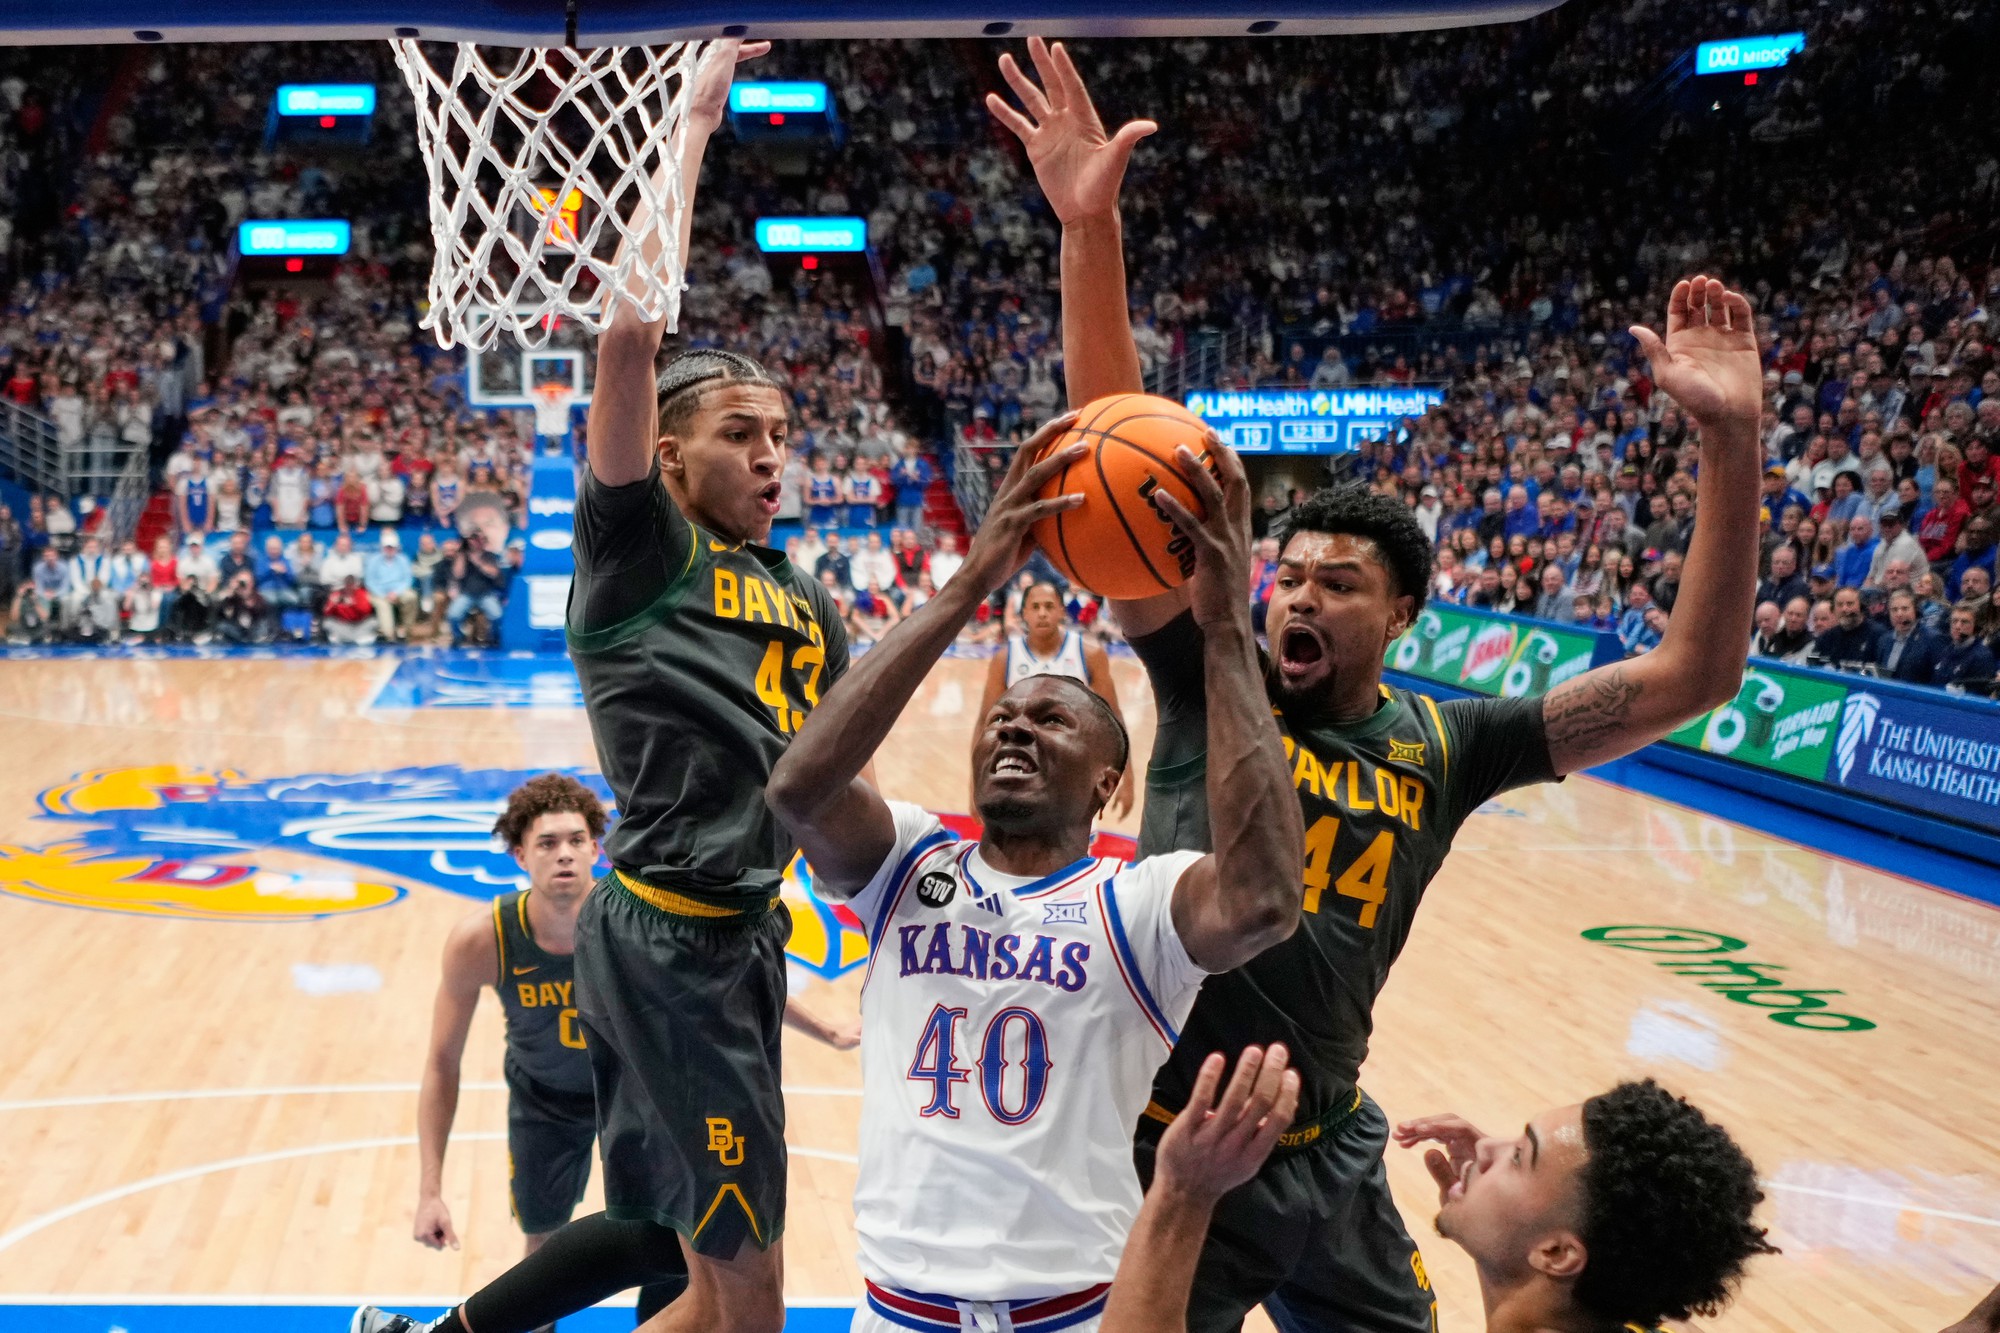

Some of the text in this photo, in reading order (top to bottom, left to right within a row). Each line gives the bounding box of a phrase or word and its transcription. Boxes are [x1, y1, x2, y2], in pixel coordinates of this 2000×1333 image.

[1879, 717, 2000, 773] THE UNIVERSIT
[1869, 747, 2000, 806] KANSAS HEALTH
[919, 875, 954, 902] SW
[1302, 815, 1395, 930] 44
[898, 921, 1091, 993] KANSAS
[517, 981, 573, 1008] BAY
[906, 1003, 1054, 1126] 40
[705, 1117, 745, 1166] BU
